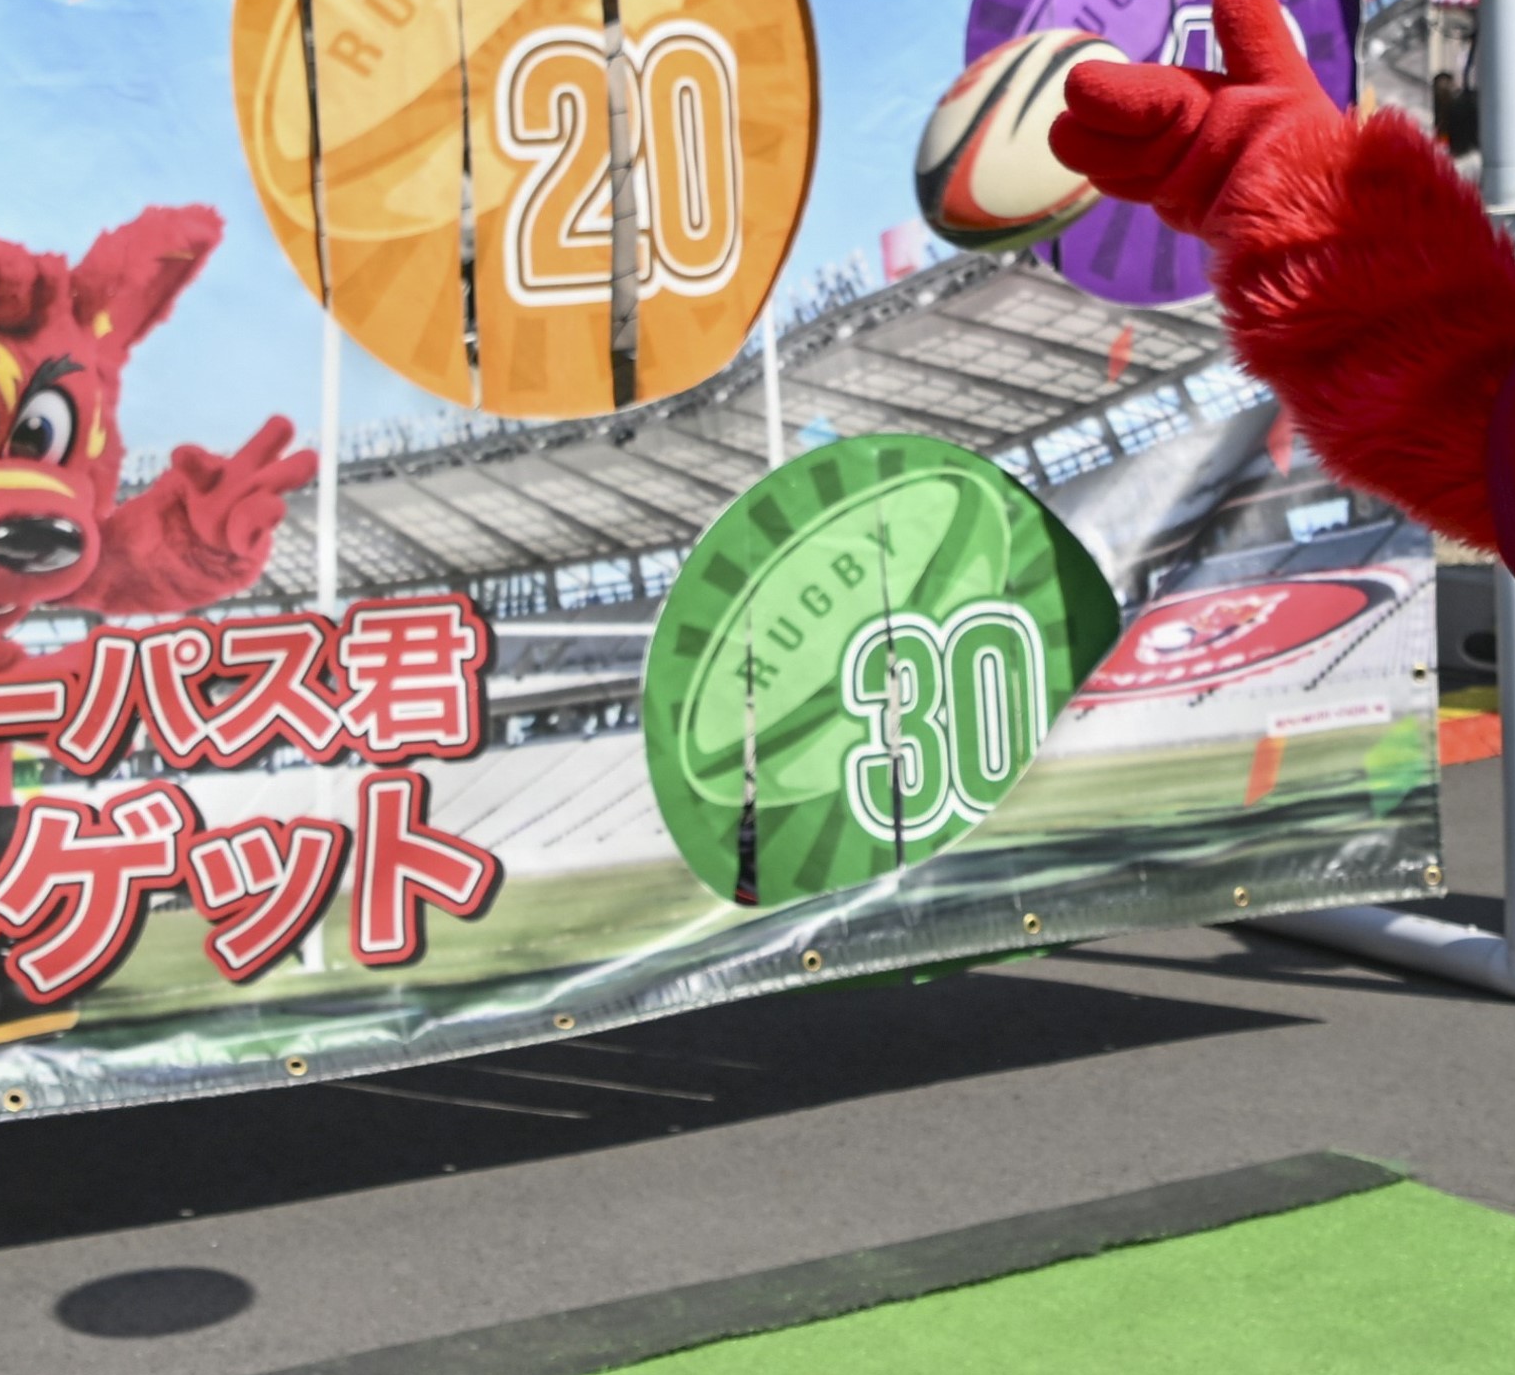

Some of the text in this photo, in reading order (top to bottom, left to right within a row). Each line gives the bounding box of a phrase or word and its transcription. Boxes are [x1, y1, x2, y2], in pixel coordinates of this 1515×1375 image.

[496, 18, 742, 309] 20
[734, 520, 900, 692] RUGBY
[840, 598, 1052, 844] 30
